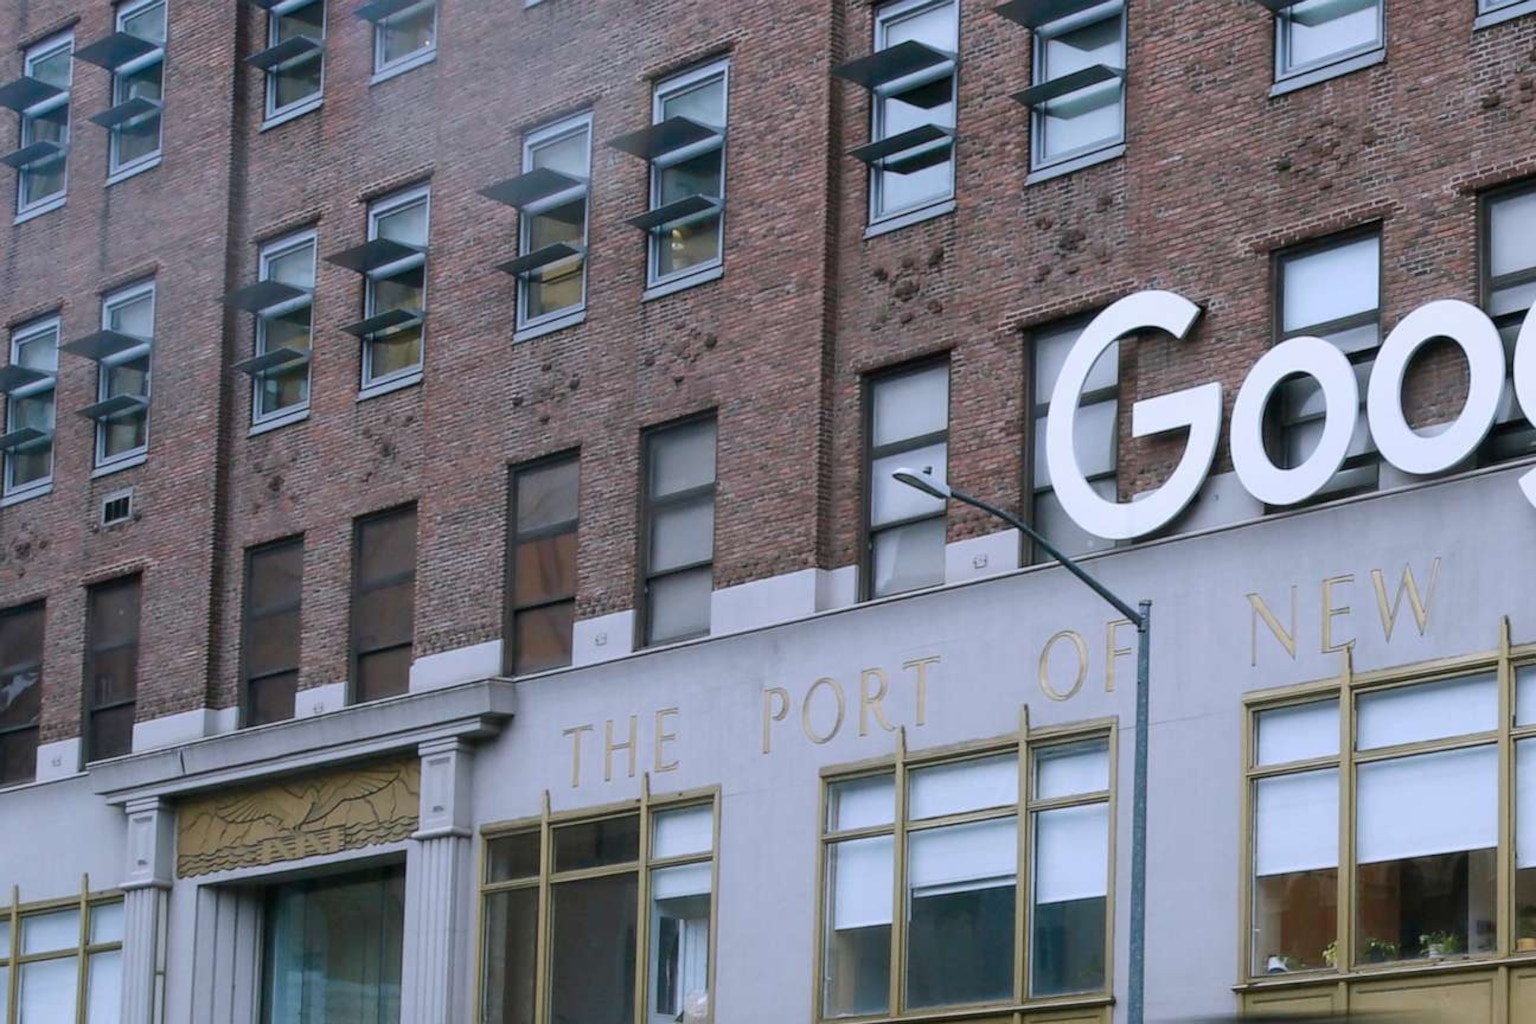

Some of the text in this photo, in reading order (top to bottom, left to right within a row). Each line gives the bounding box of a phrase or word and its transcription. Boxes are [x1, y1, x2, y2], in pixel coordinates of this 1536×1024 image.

[562, 706, 681, 788] THE
[761, 655, 941, 755] PORT
[1037, 618, 1134, 703] OF
[1246, 556, 1442, 667] NEW
